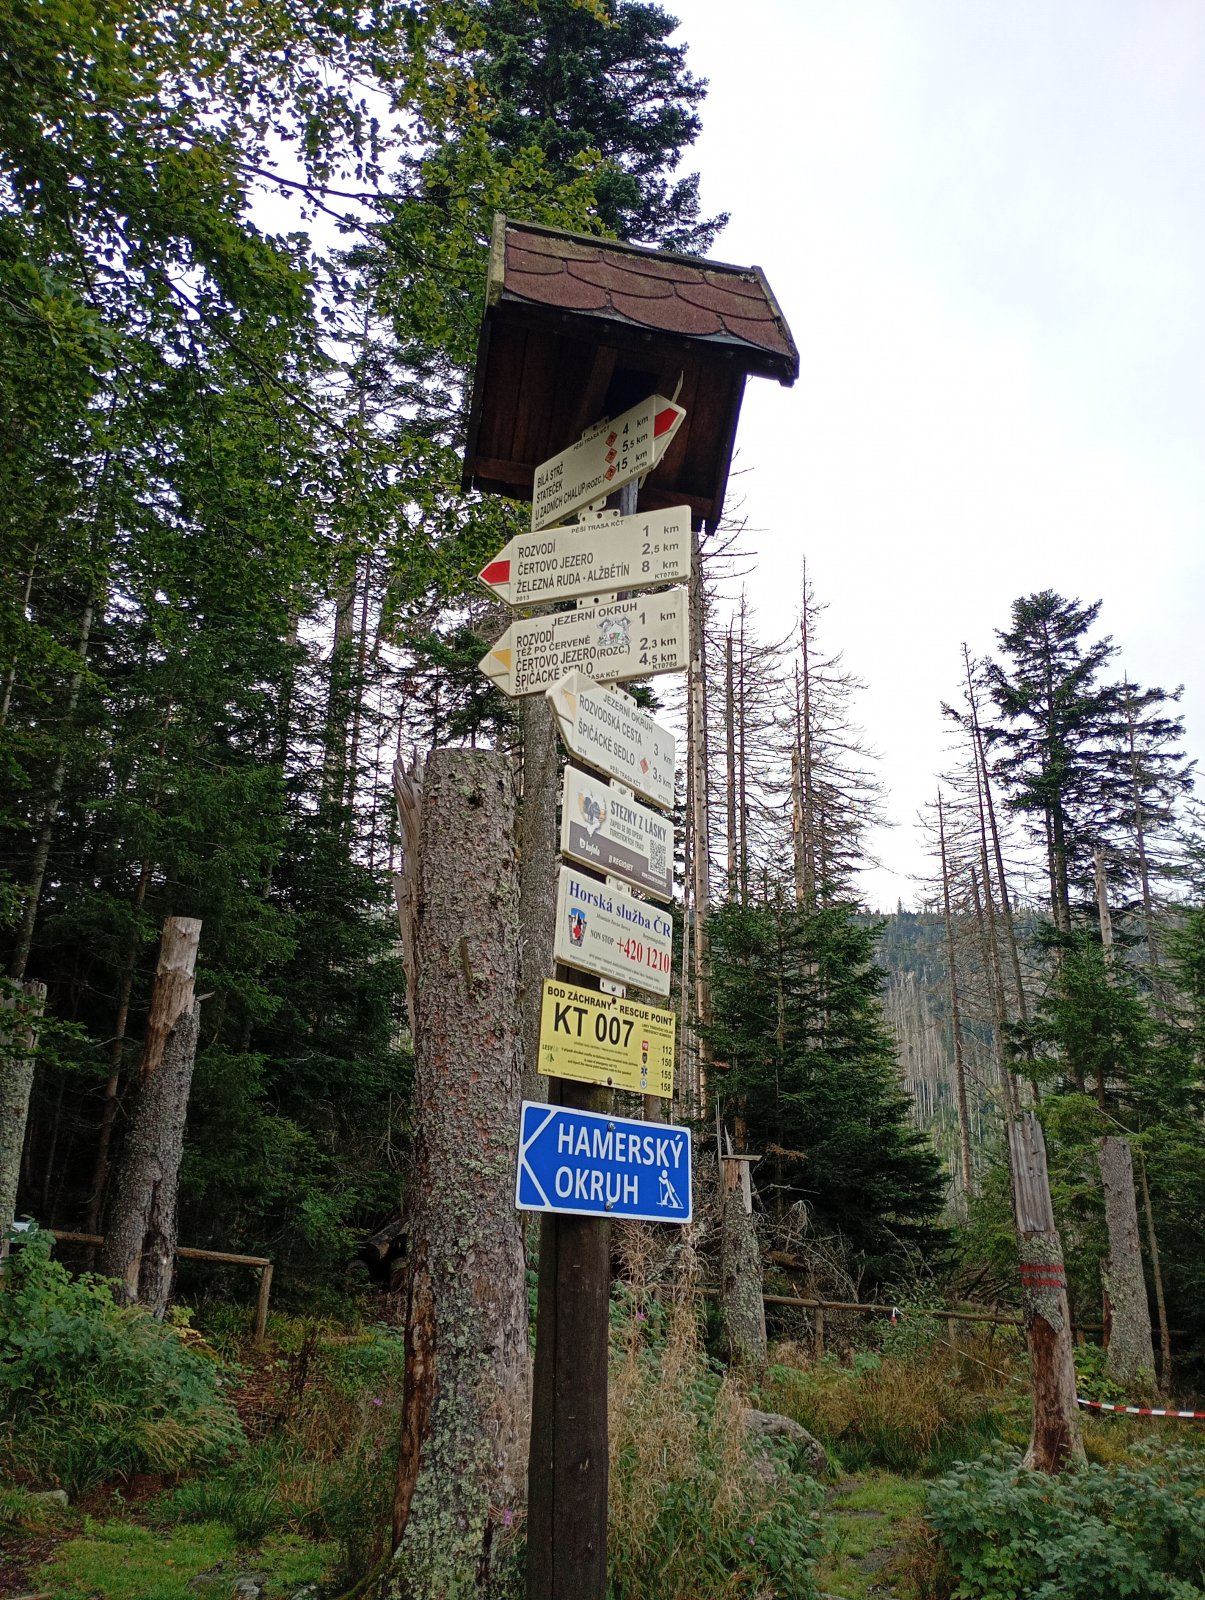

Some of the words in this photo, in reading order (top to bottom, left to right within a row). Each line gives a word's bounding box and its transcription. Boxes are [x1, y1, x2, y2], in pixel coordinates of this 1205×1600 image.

[537, 469, 549, 488] BÍLÁ
[550, 461, 563, 481] STRŽ
[622, 423, 629, 435] 4
[637, 416, 649, 428] km
[584, 431, 600, 444] TRASA
[535, 509, 540, 520] U
[540, 495, 563, 518] ZADNÍCH
[616, 457, 628, 472] 15
[635, 451, 647, 462] km
[537, 479, 563, 504] STATEČEK
[622, 440, 634, 453] 5,5
[636, 433, 648, 444] km
[518, 539, 556, 559] ROZVODÍ
[642, 525, 649, 537] 1
[663, 525, 680, 534] km
[571, 525, 586, 534] PĚŠÍ
[587, 523, 609, 532] TRASA
[610, 519, 624, 527] KČT
[516, 575, 554, 594] ŽELEZNÁ
[556, 571, 581, 587] RUDA
[587, 562, 630, 582] ALŽBĚTÍN
[641, 561, 650, 573] 8
[662, 560, 678, 569] km
[517, 558, 558, 576] ČERTOVO
[560, 552, 594, 569] JEZERO
[642, 543, 660, 556] 2,5
[663, 543, 679, 552] km
[516, 625, 555, 648] ROZVODÍ
[639, 612, 646, 625] 1
[660, 611, 676, 621] km
[551, 608, 596, 627] JEZERNÍ
[598, 602, 638, 618] OKRUH
[516, 647, 533, 658] TÉŽ
[534, 645, 546, 654] PO
[549, 634, 591, 652] ČERVENÉ
[516, 656, 559, 673] ČERTOVO
[639, 637, 657, 651] 2,3
[661, 637, 677, 647] km
[515, 665, 560, 687] ŠPIČÁCKÉ
[639, 652, 658, 666] 4,5
[661, 652, 677, 662] km
[605, 670, 620, 678] KČT
[579, 694, 621, 733] ROZVODSKÁ
[621, 722, 642, 746] CESTA
[653, 743, 659, 756] 3
[664, 753, 673, 765] km
[603, 695, 631, 718] JEZERNÍ
[631, 713, 653, 733] OKRUH
[578, 720, 612, 753] ŠPIČÁCKÉ
[613, 742, 635, 766] SEDLO
[652, 767, 662, 783] 3,5
[662, 777, 672, 789] km
[610, 800, 637, 830] STEZKY
[638, 816, 643, 830] Z
[644, 816, 667, 842] LÁSKY
[569, 880, 613, 913] Horská
[616, 904, 651, 930] služba
[653, 915, 671, 938] ČR
[590, 929, 601, 940] NON
[601, 934, 615, 946] STOP
[616, 936, 643, 964] +420
[646, 946, 670, 974] 1210
[547, 986, 566, 999] BOD
[568, 991, 612, 1011] ZÁCHRANY
[619, 1005, 649, 1021] RESCUE
[651, 1012, 673, 1027] POINT
[554, 1002, 588, 1037] KT
[595, 1013, 635, 1048] 007
[661, 1057, 672, 1068] 150
[662, 1045, 672, 1055] 112
[660, 1070, 672, 1080] 155
[660, 1082, 671, 1093] 158
[557, 1122, 684, 1169] HAMERSKÝ
[554, 1166, 639, 1205] OKRUH
